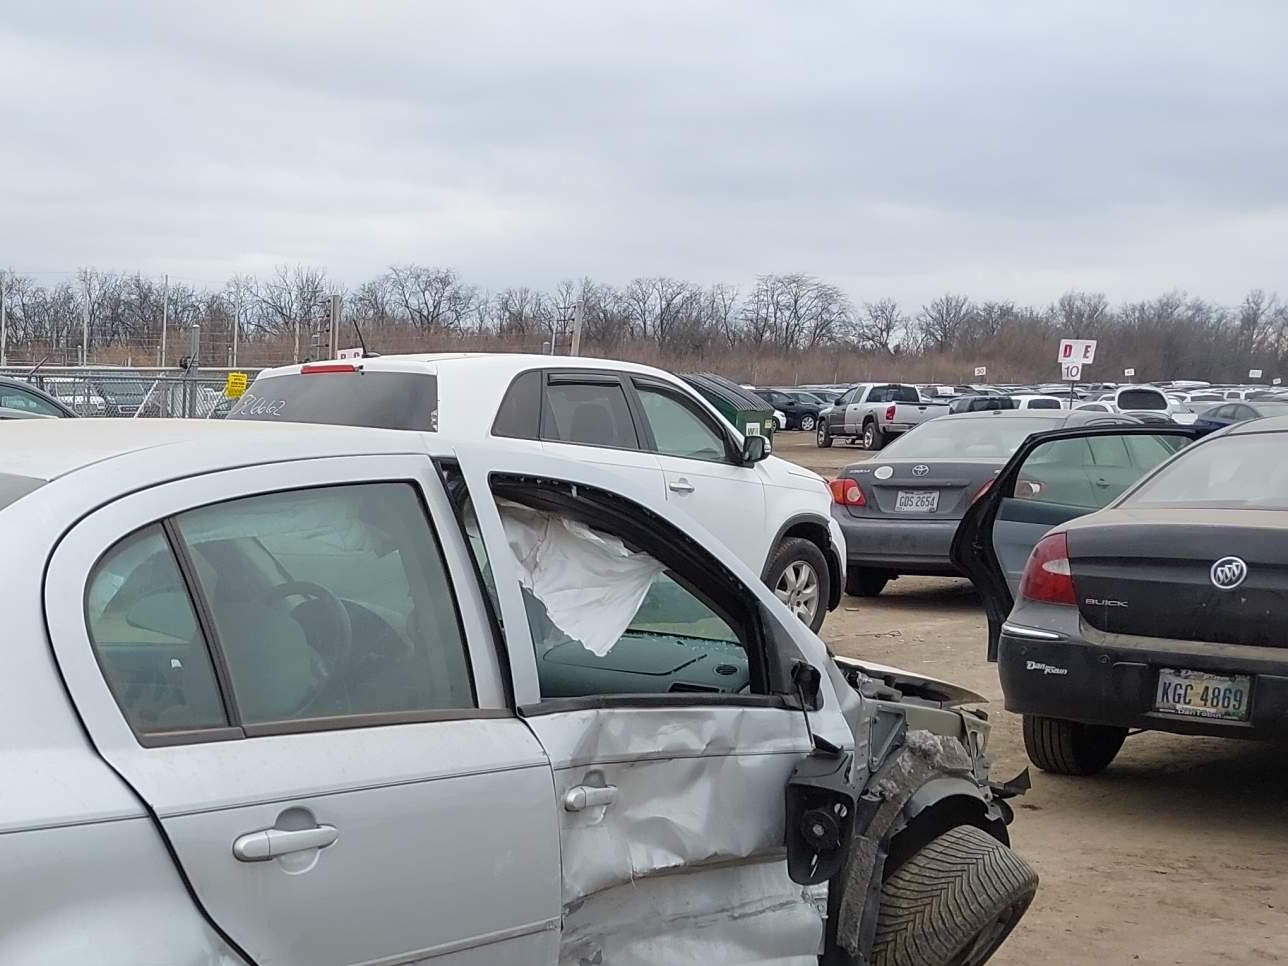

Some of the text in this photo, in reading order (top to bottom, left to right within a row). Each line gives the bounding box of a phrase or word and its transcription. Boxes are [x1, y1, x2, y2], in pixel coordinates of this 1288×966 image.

[1063, 345, 1091, 359] D E
[1064, 365, 1080, 378] 10
[915, 495, 936, 507] 2654
[1085, 598, 1129, 608] BUICK
[1161, 681, 1244, 711] KGC 4869
